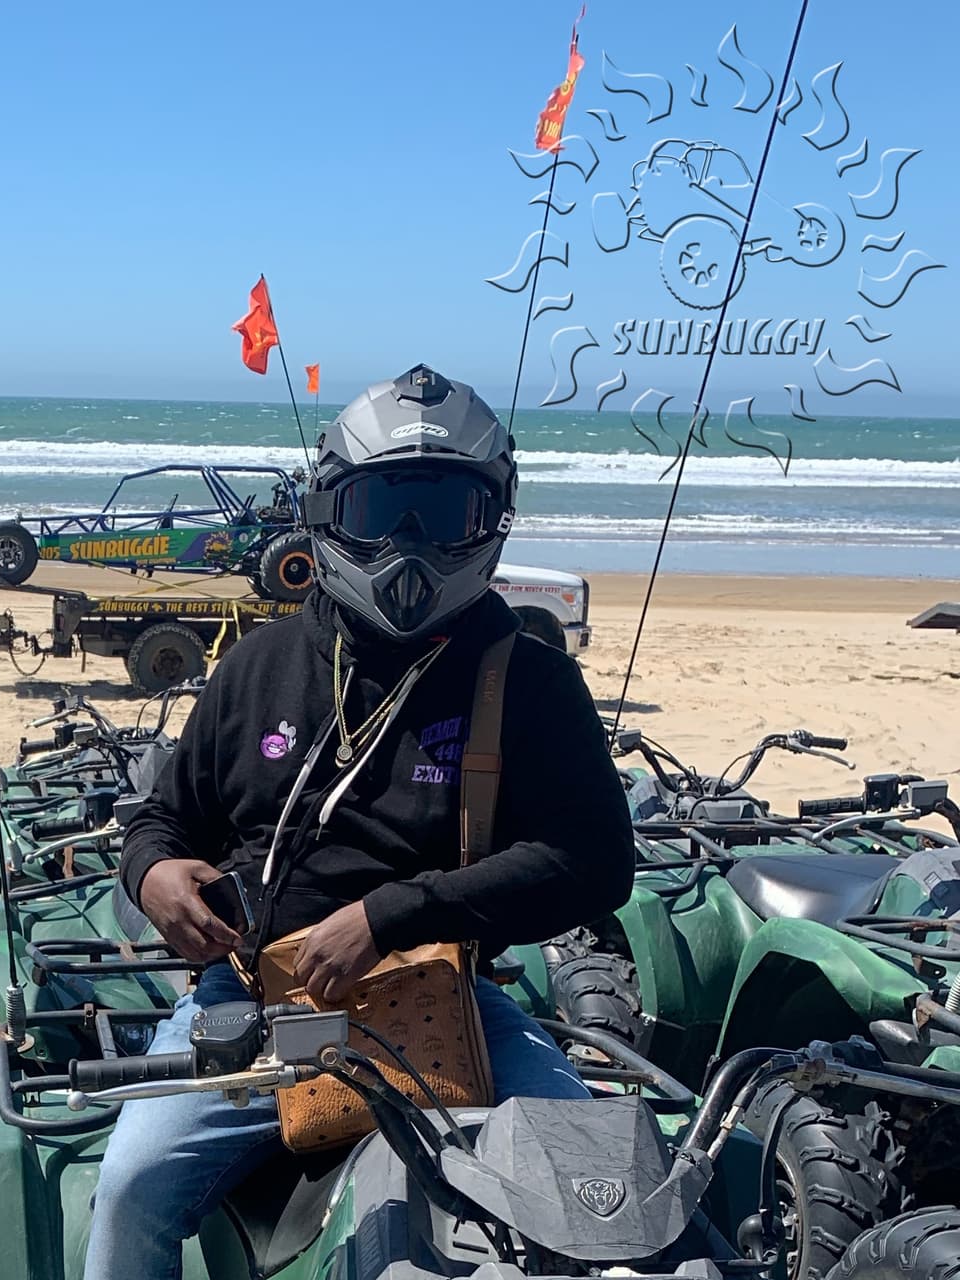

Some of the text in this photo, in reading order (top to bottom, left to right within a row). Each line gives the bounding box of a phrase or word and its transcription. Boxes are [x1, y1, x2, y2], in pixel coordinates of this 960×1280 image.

[69, 536, 170, 560] SUNBUGGIE
[99, 600, 149, 612] SUNBUGGY
[166, 602, 184, 612] THE
